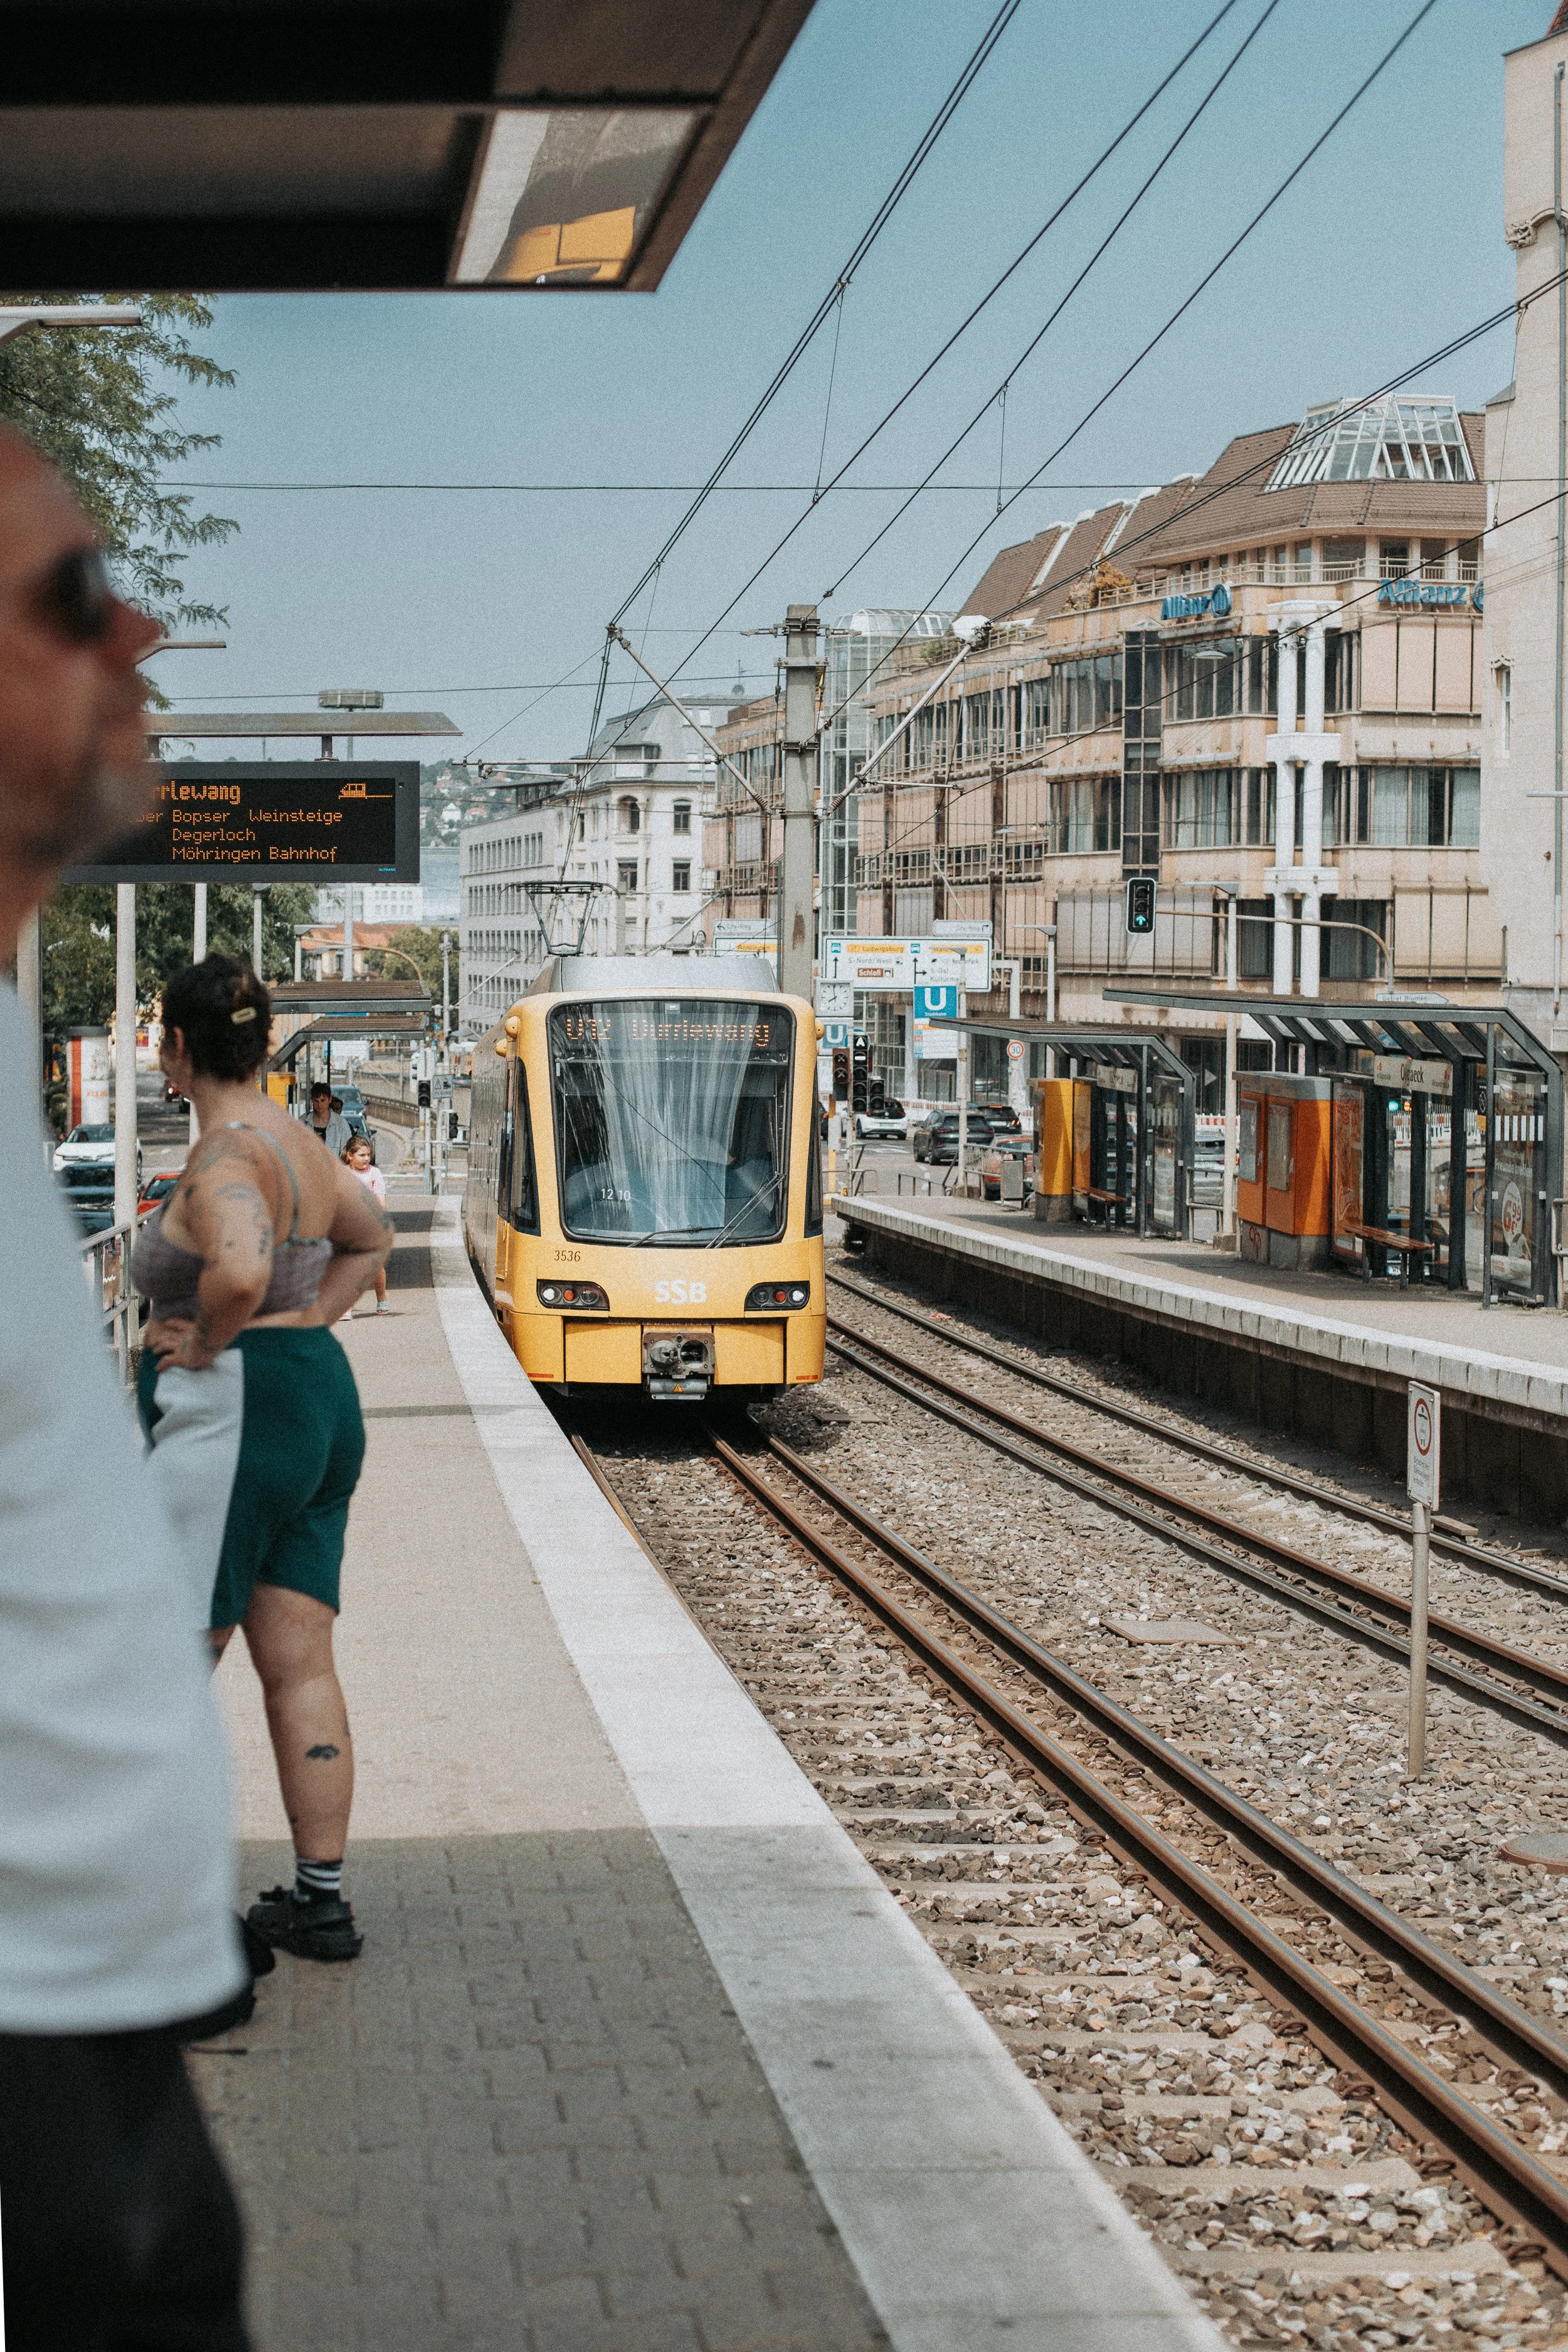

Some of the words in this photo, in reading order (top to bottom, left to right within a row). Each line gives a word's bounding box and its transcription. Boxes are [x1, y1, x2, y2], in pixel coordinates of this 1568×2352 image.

[1378, 578, 1467, 605] Allianz
[1160, 593, 1211, 620] Allianz
[151, 780, 241, 805] rrlewang
[172, 809, 230, 825] Bopser
[250, 809, 342, 825] Weinsteige
[172, 829, 256, 844] Degerloch
[172, 847, 260, 863] Möhringen
[270, 846, 337, 862] Bahnhof
[924, 987, 946, 1011] U
[826, 1025, 844, 1044] U
[1011, 1046, 1020, 1054] 30
[1400, 1063, 1424, 1086] Olgaeck
[554, 1249, 581, 1262] 3536
[654, 1279, 707, 1305] SSB
